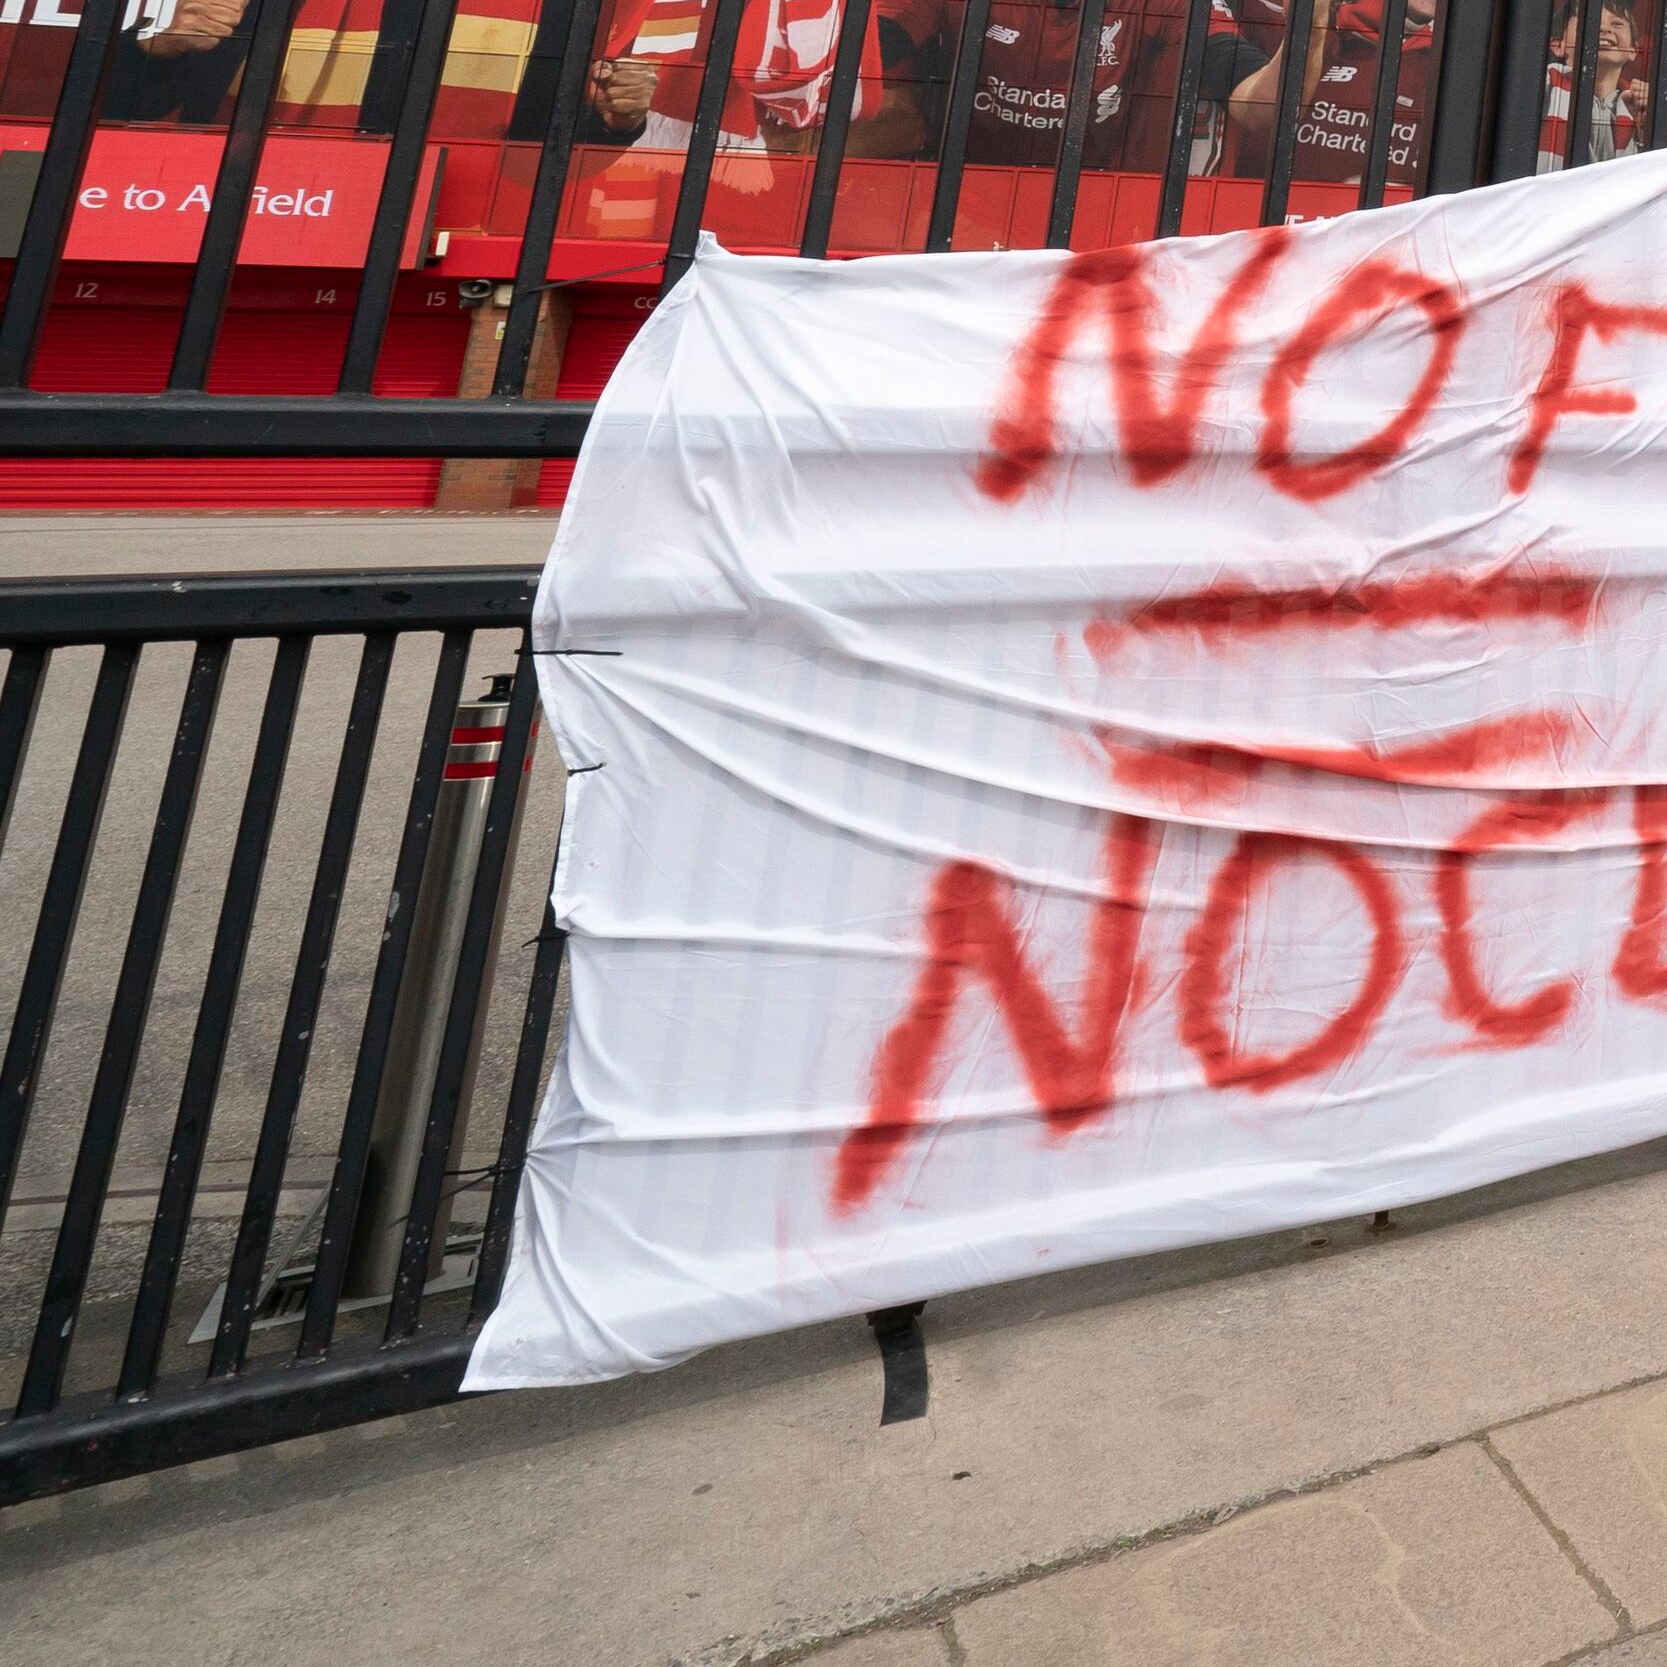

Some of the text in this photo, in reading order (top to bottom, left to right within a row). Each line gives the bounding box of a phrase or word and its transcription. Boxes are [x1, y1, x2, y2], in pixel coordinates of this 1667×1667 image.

[985, 75, 1067, 110] Standa
[1311, 100, 1417, 143] Stanrd
[123, 182, 166, 212] to
[75, 282, 99, 299] 12
[314, 288, 337, 304] 14
[426, 291, 448, 307] 15
[975, 226, 1470, 505] NO
[830, 811, 1402, 1217] NO
